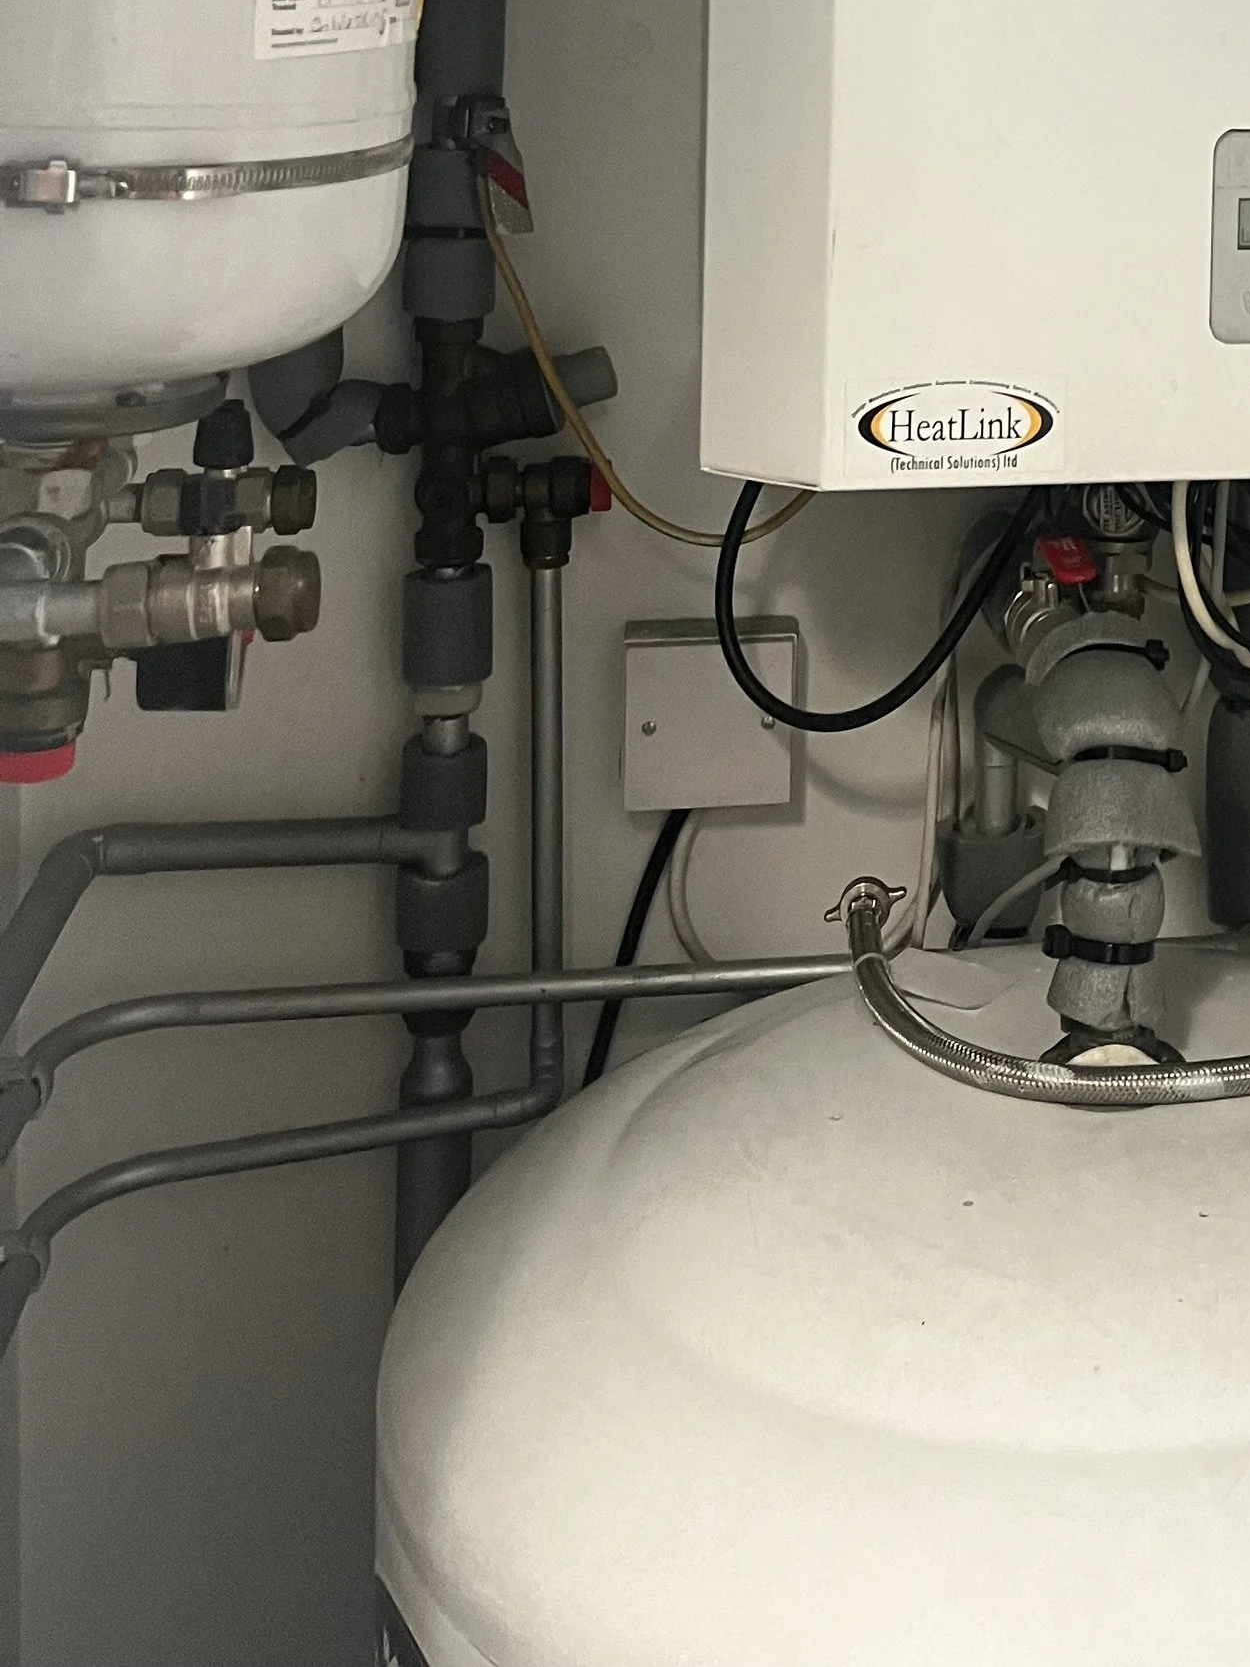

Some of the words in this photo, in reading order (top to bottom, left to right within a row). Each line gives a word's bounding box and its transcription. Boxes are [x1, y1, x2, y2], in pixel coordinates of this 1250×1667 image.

[888, 407, 1022, 443] HeatLink
[890, 456, 944, 474] (Technical
[947, 455, 1000, 472] Solutions)
[1003, 454, 1018, 469] ltd
